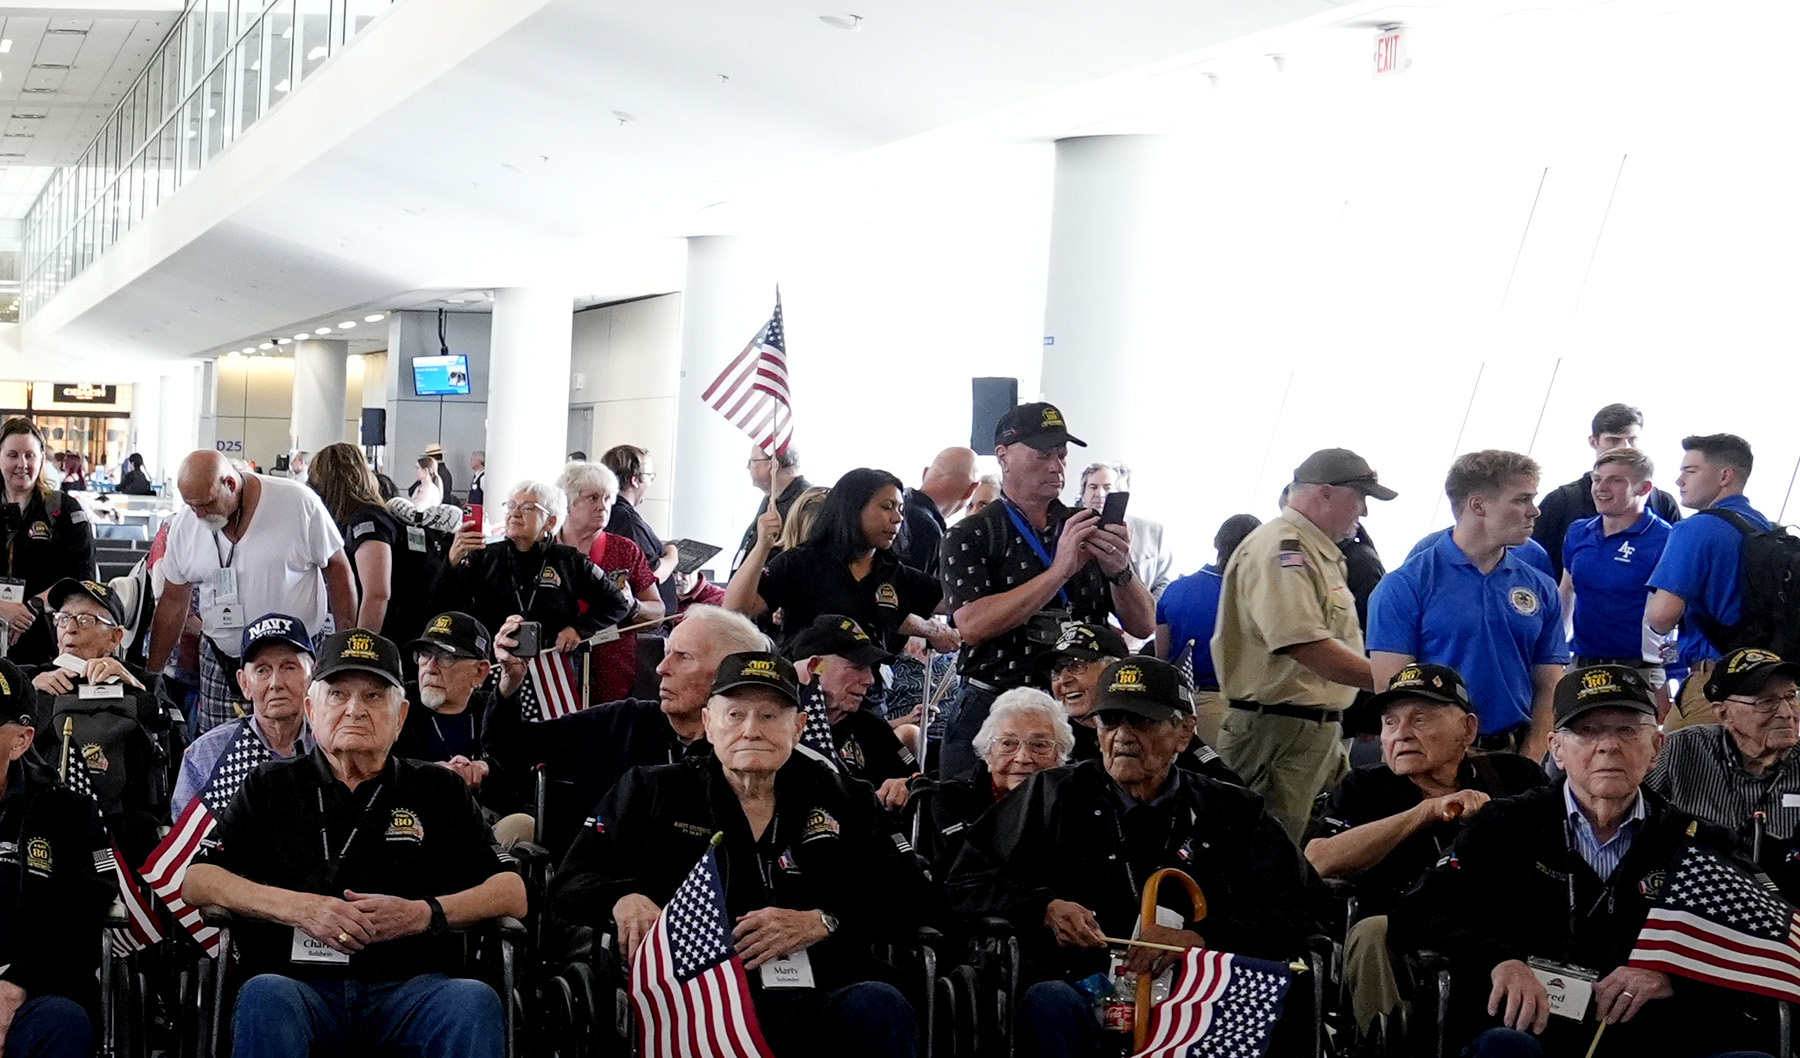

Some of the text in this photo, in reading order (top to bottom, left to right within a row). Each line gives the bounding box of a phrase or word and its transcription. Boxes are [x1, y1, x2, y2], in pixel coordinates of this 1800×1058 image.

[1377, 34, 1401, 74] EXIT
[216, 440, 243, 452] D25
[248, 617, 293, 641] NAVY
[393, 817, 413, 827] 80
[32, 848, 48, 859] 80
[773, 966, 798, 977] Marty
[1547, 992, 1566, 1003] red
